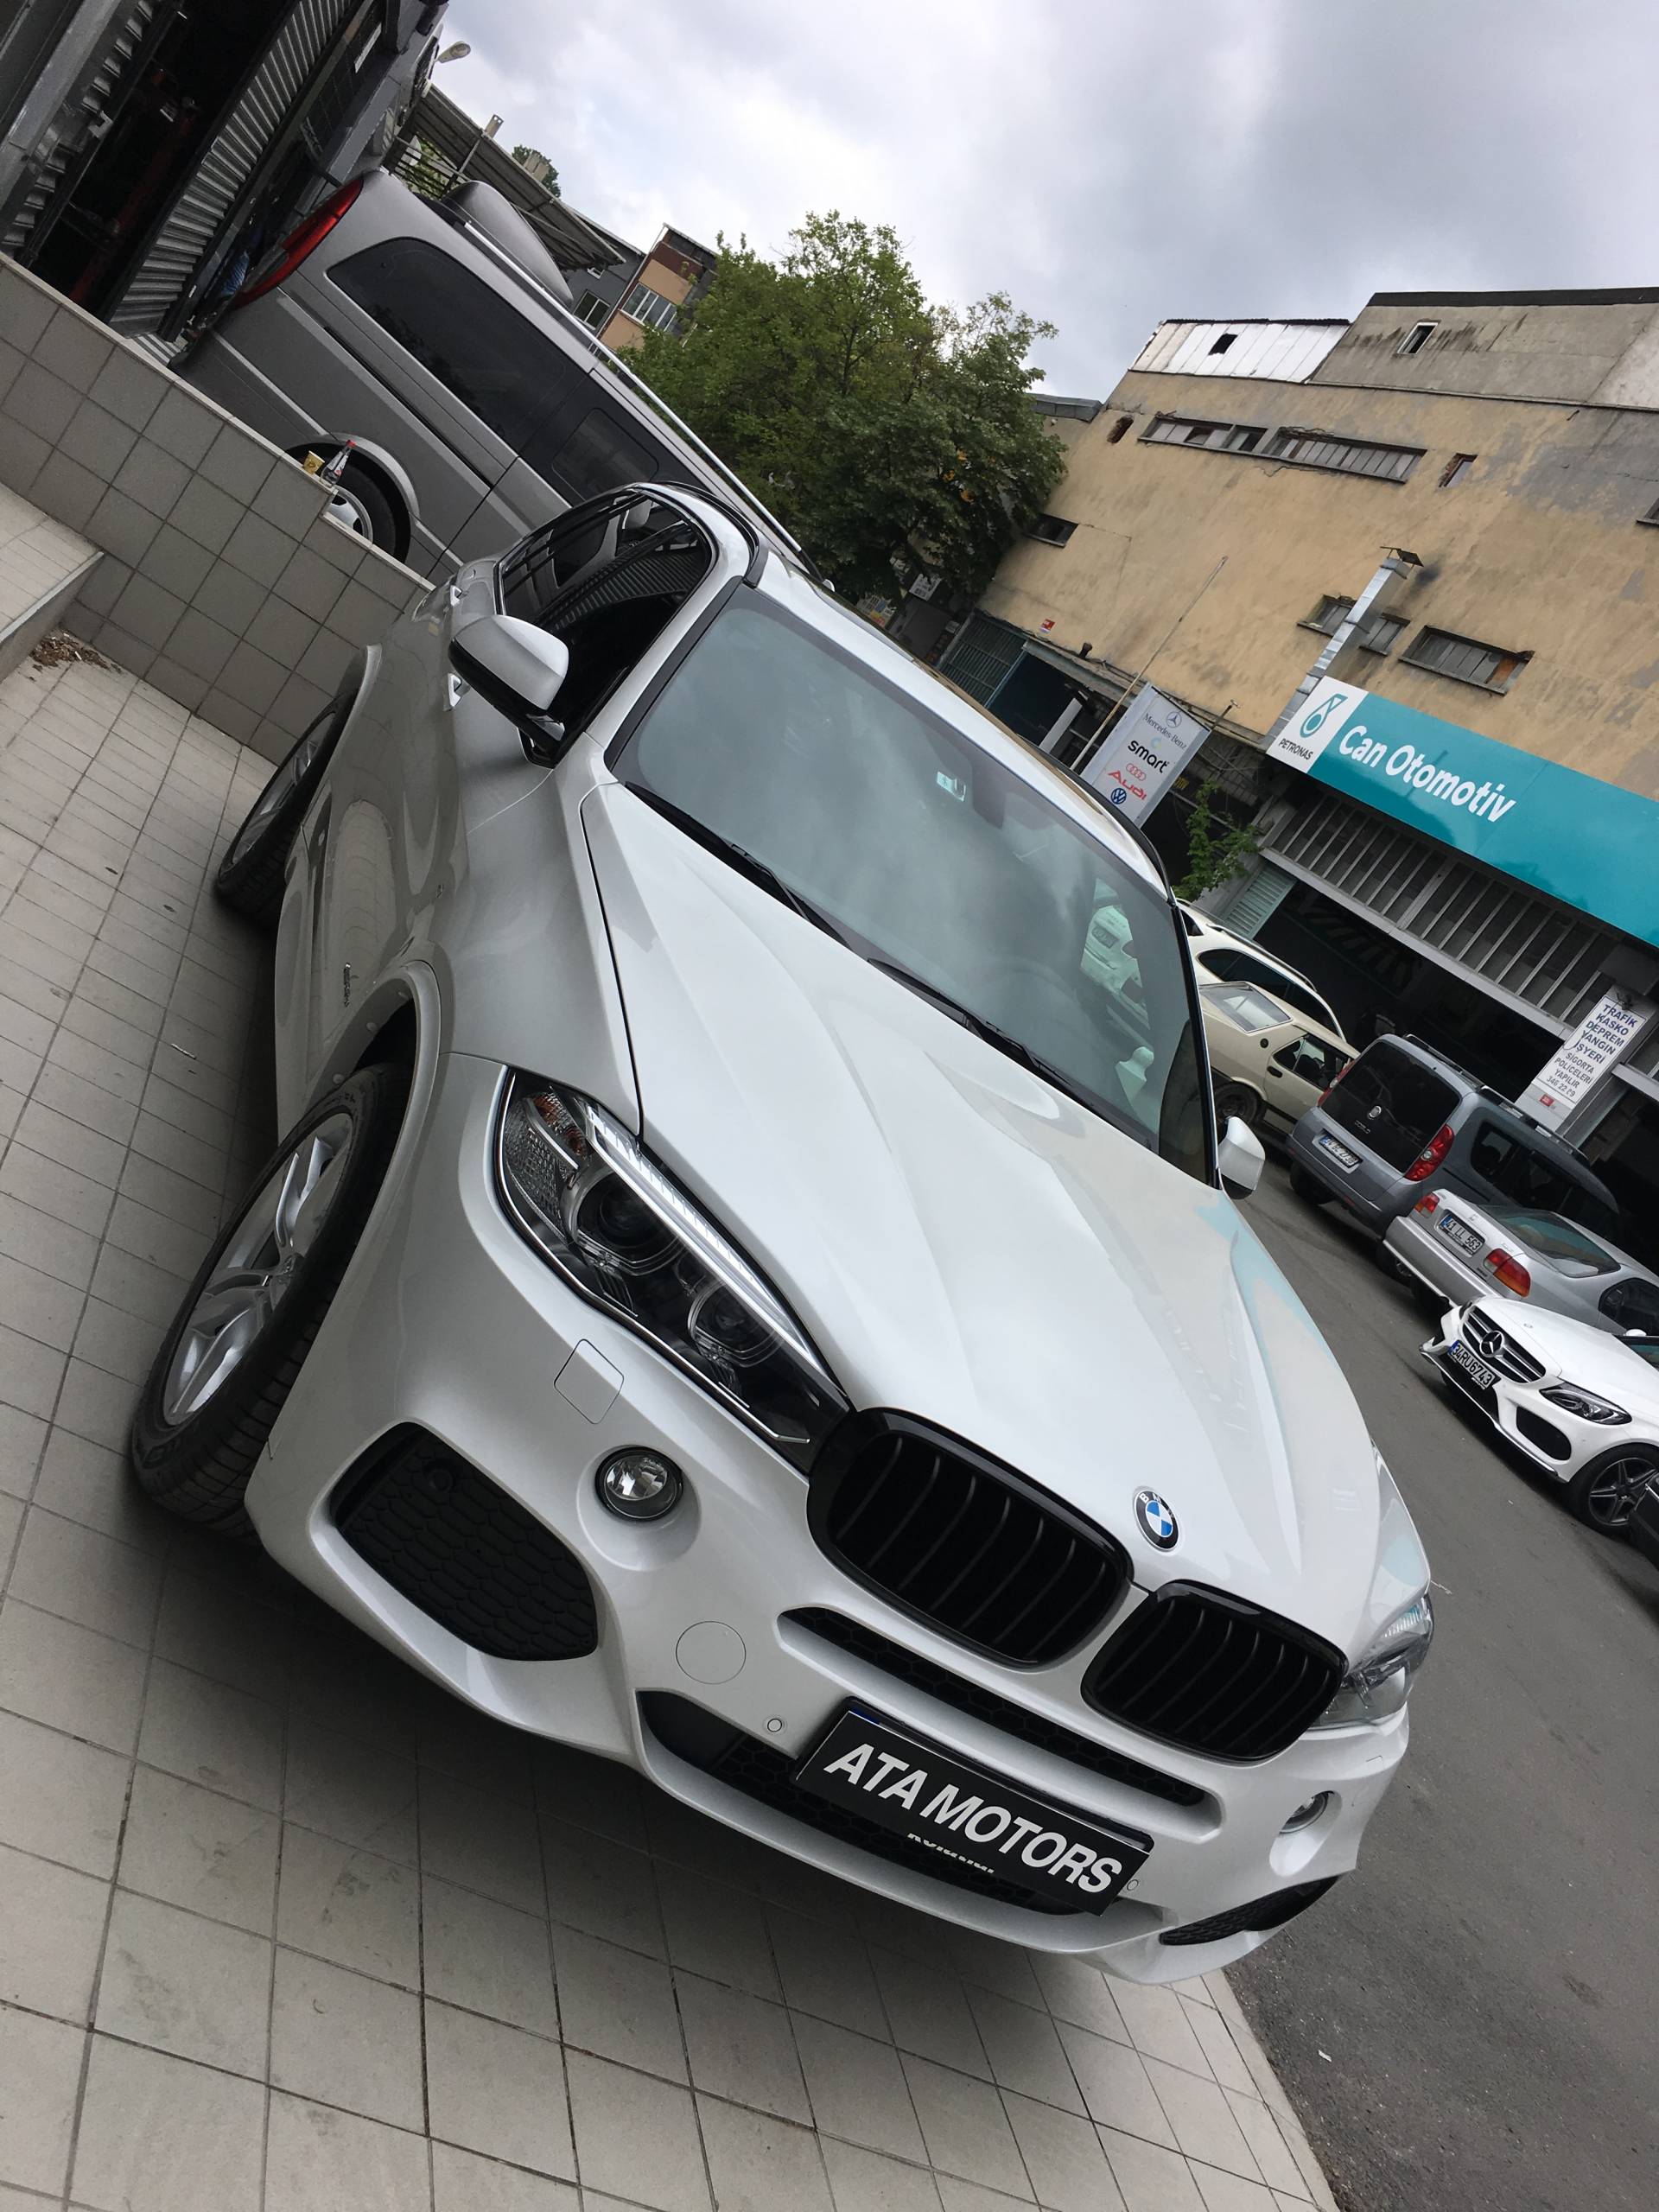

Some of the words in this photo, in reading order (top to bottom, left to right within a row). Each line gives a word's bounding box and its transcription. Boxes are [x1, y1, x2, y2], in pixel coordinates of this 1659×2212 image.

[1143, 713, 1187, 750] Mercedes-Benz
[1128, 740, 1169, 773] smart
[1278, 738, 1313, 761] PETRONAS
[1338, 725, 1388, 768] Can
[1385, 745, 1517, 823] Otomotiv
[1585, 1020, 1625, 1047] DEPREM
[1595, 1013, 1630, 1036] KASKO
[1581, 1029, 1617, 1055] YANGIN
[1453, 1226, 1464, 1239] LL
[1465, 1236, 1482, 1251] 563
[823, 1743, 928, 1810] ATA
[919, 1783, 1122, 1893] MOTORS
